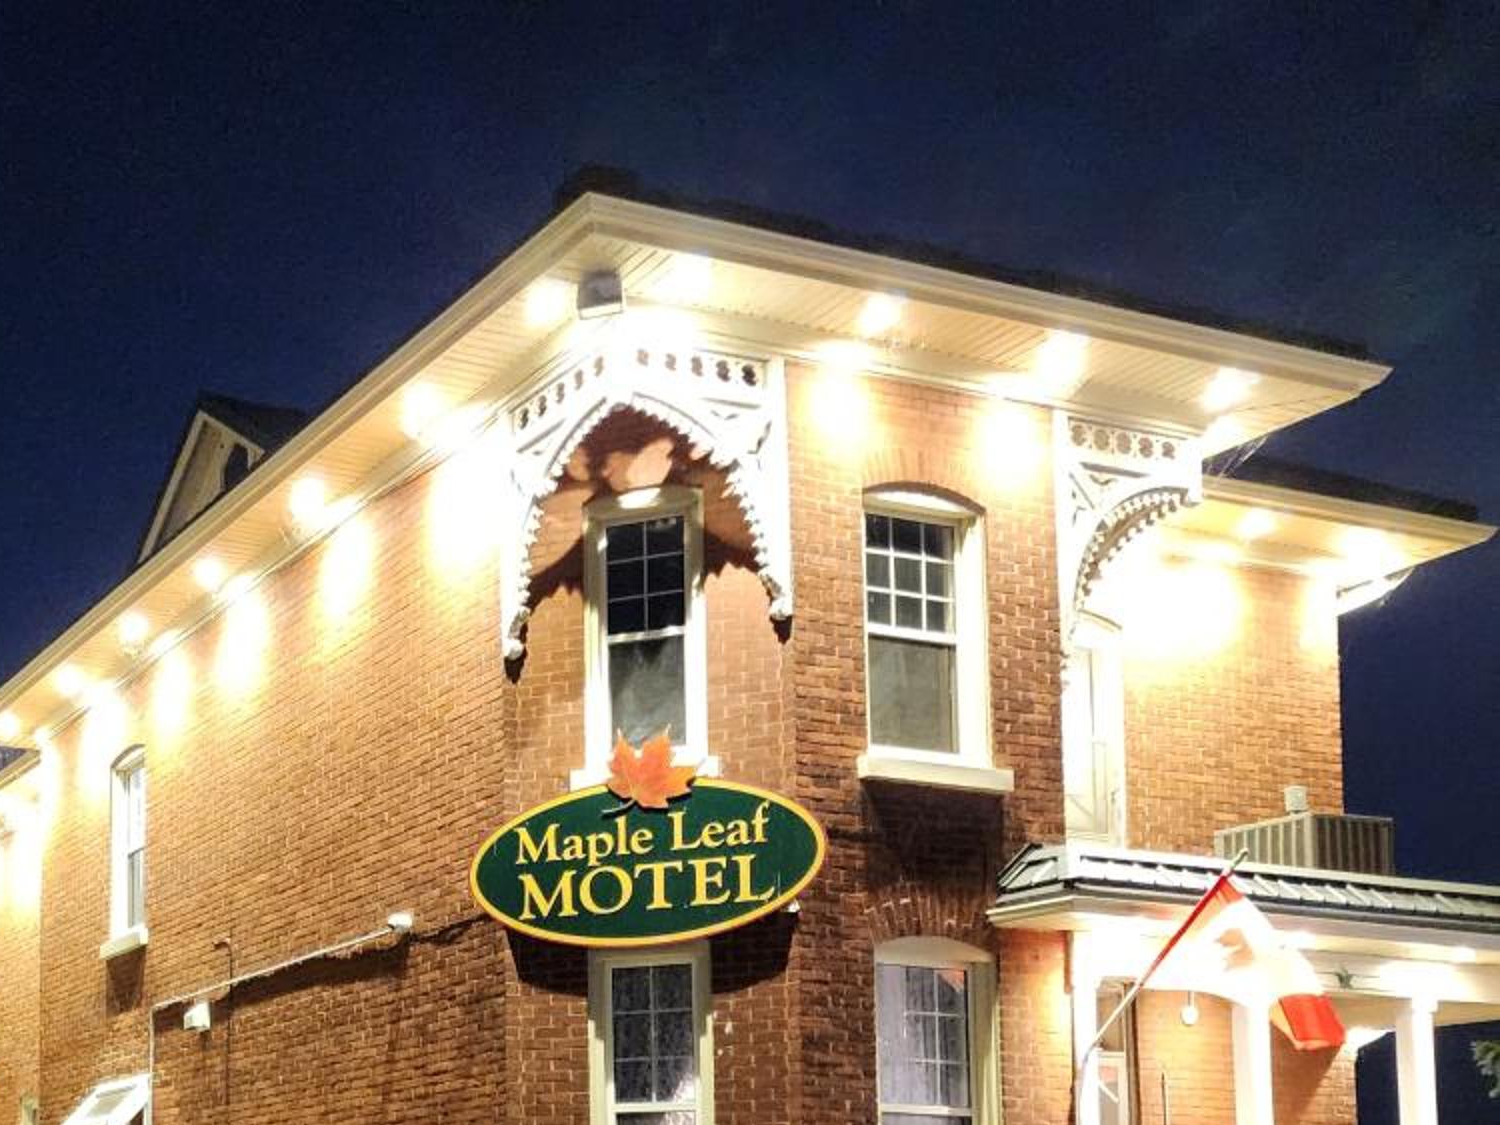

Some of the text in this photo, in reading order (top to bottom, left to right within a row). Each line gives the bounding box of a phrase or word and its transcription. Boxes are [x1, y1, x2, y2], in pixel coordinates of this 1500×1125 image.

[515, 800, 770, 867] Maple Leaf
[518, 854, 775, 921] MOTEL
